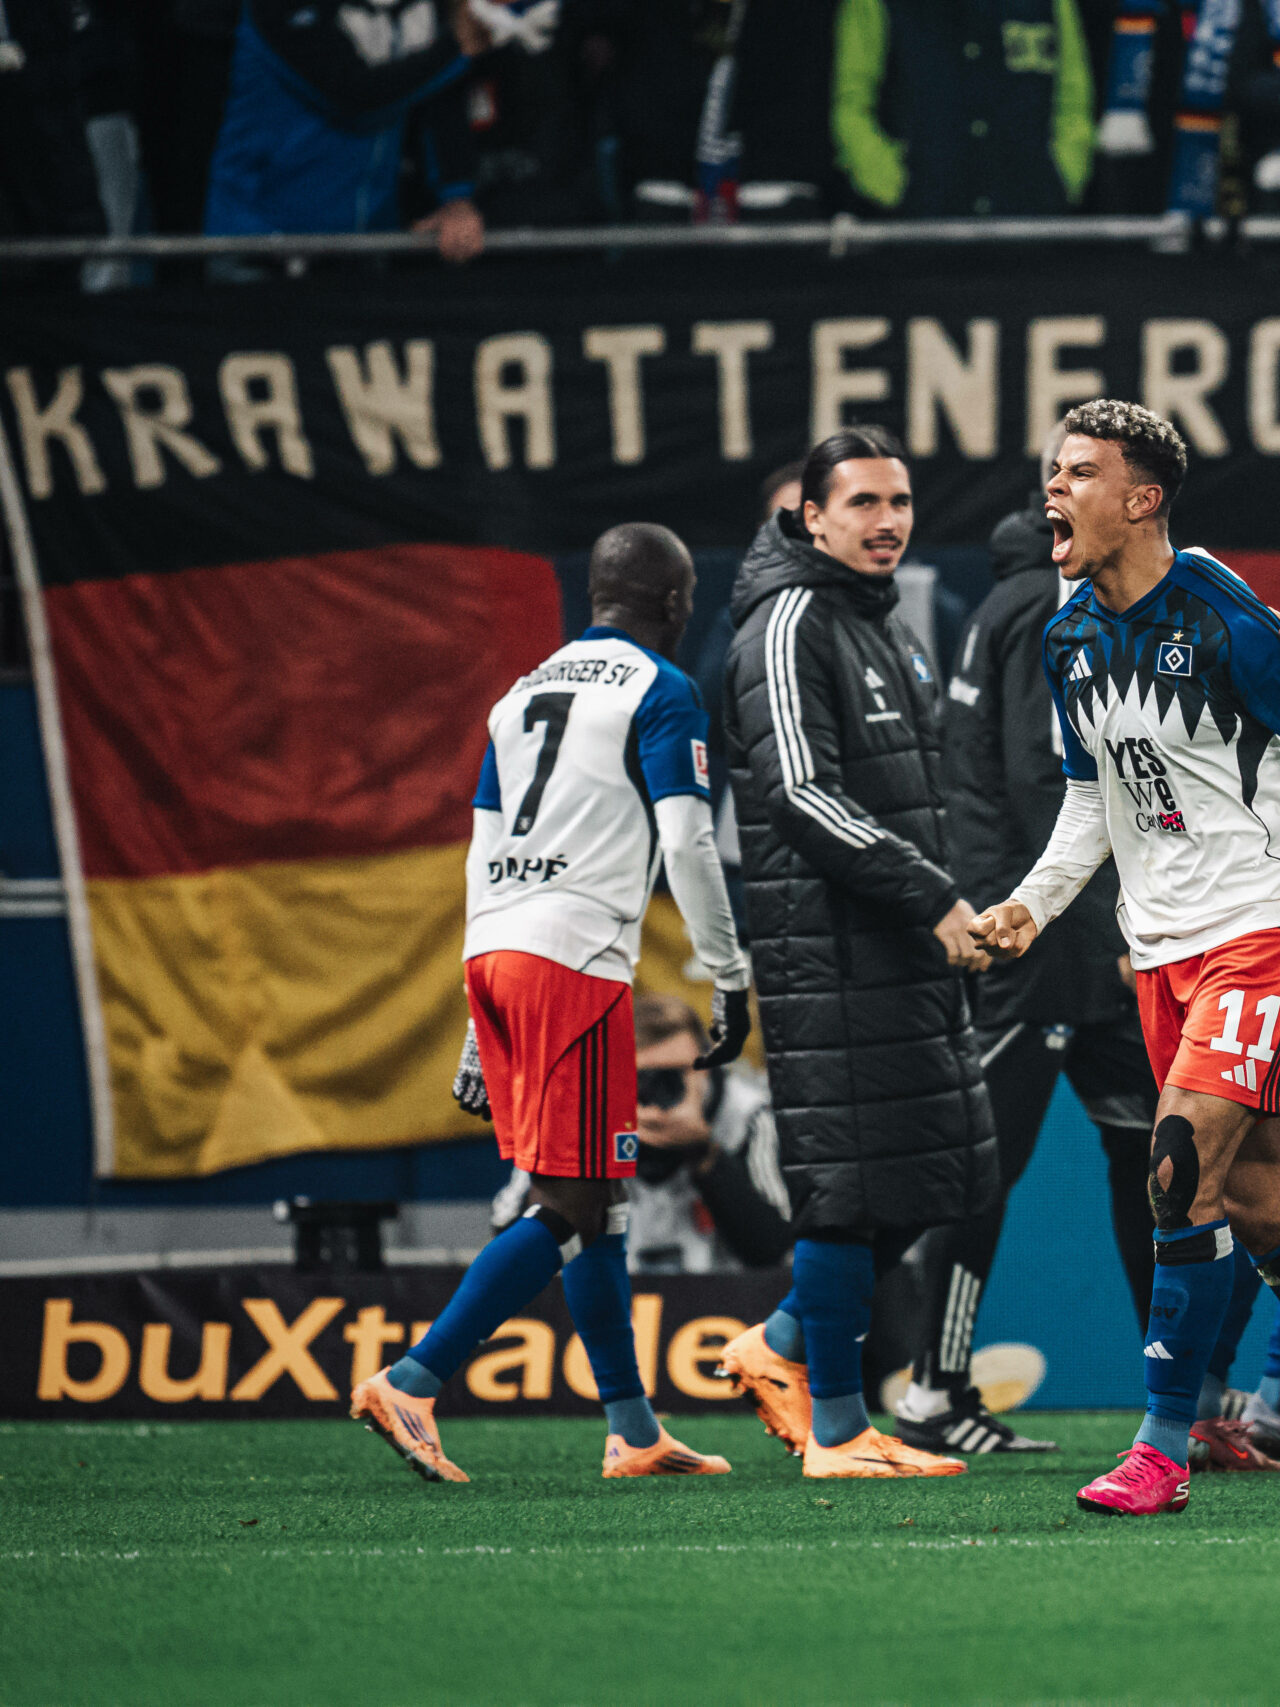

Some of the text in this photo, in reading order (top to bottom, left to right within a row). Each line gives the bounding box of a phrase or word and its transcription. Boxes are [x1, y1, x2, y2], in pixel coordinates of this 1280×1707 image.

[604, 663, 640, 687] SV
[511, 692, 577, 836] 7
[1104, 737, 1167, 780] YES
[1122, 777, 1177, 811] We
[37, 1295, 749, 1402] buXtade
